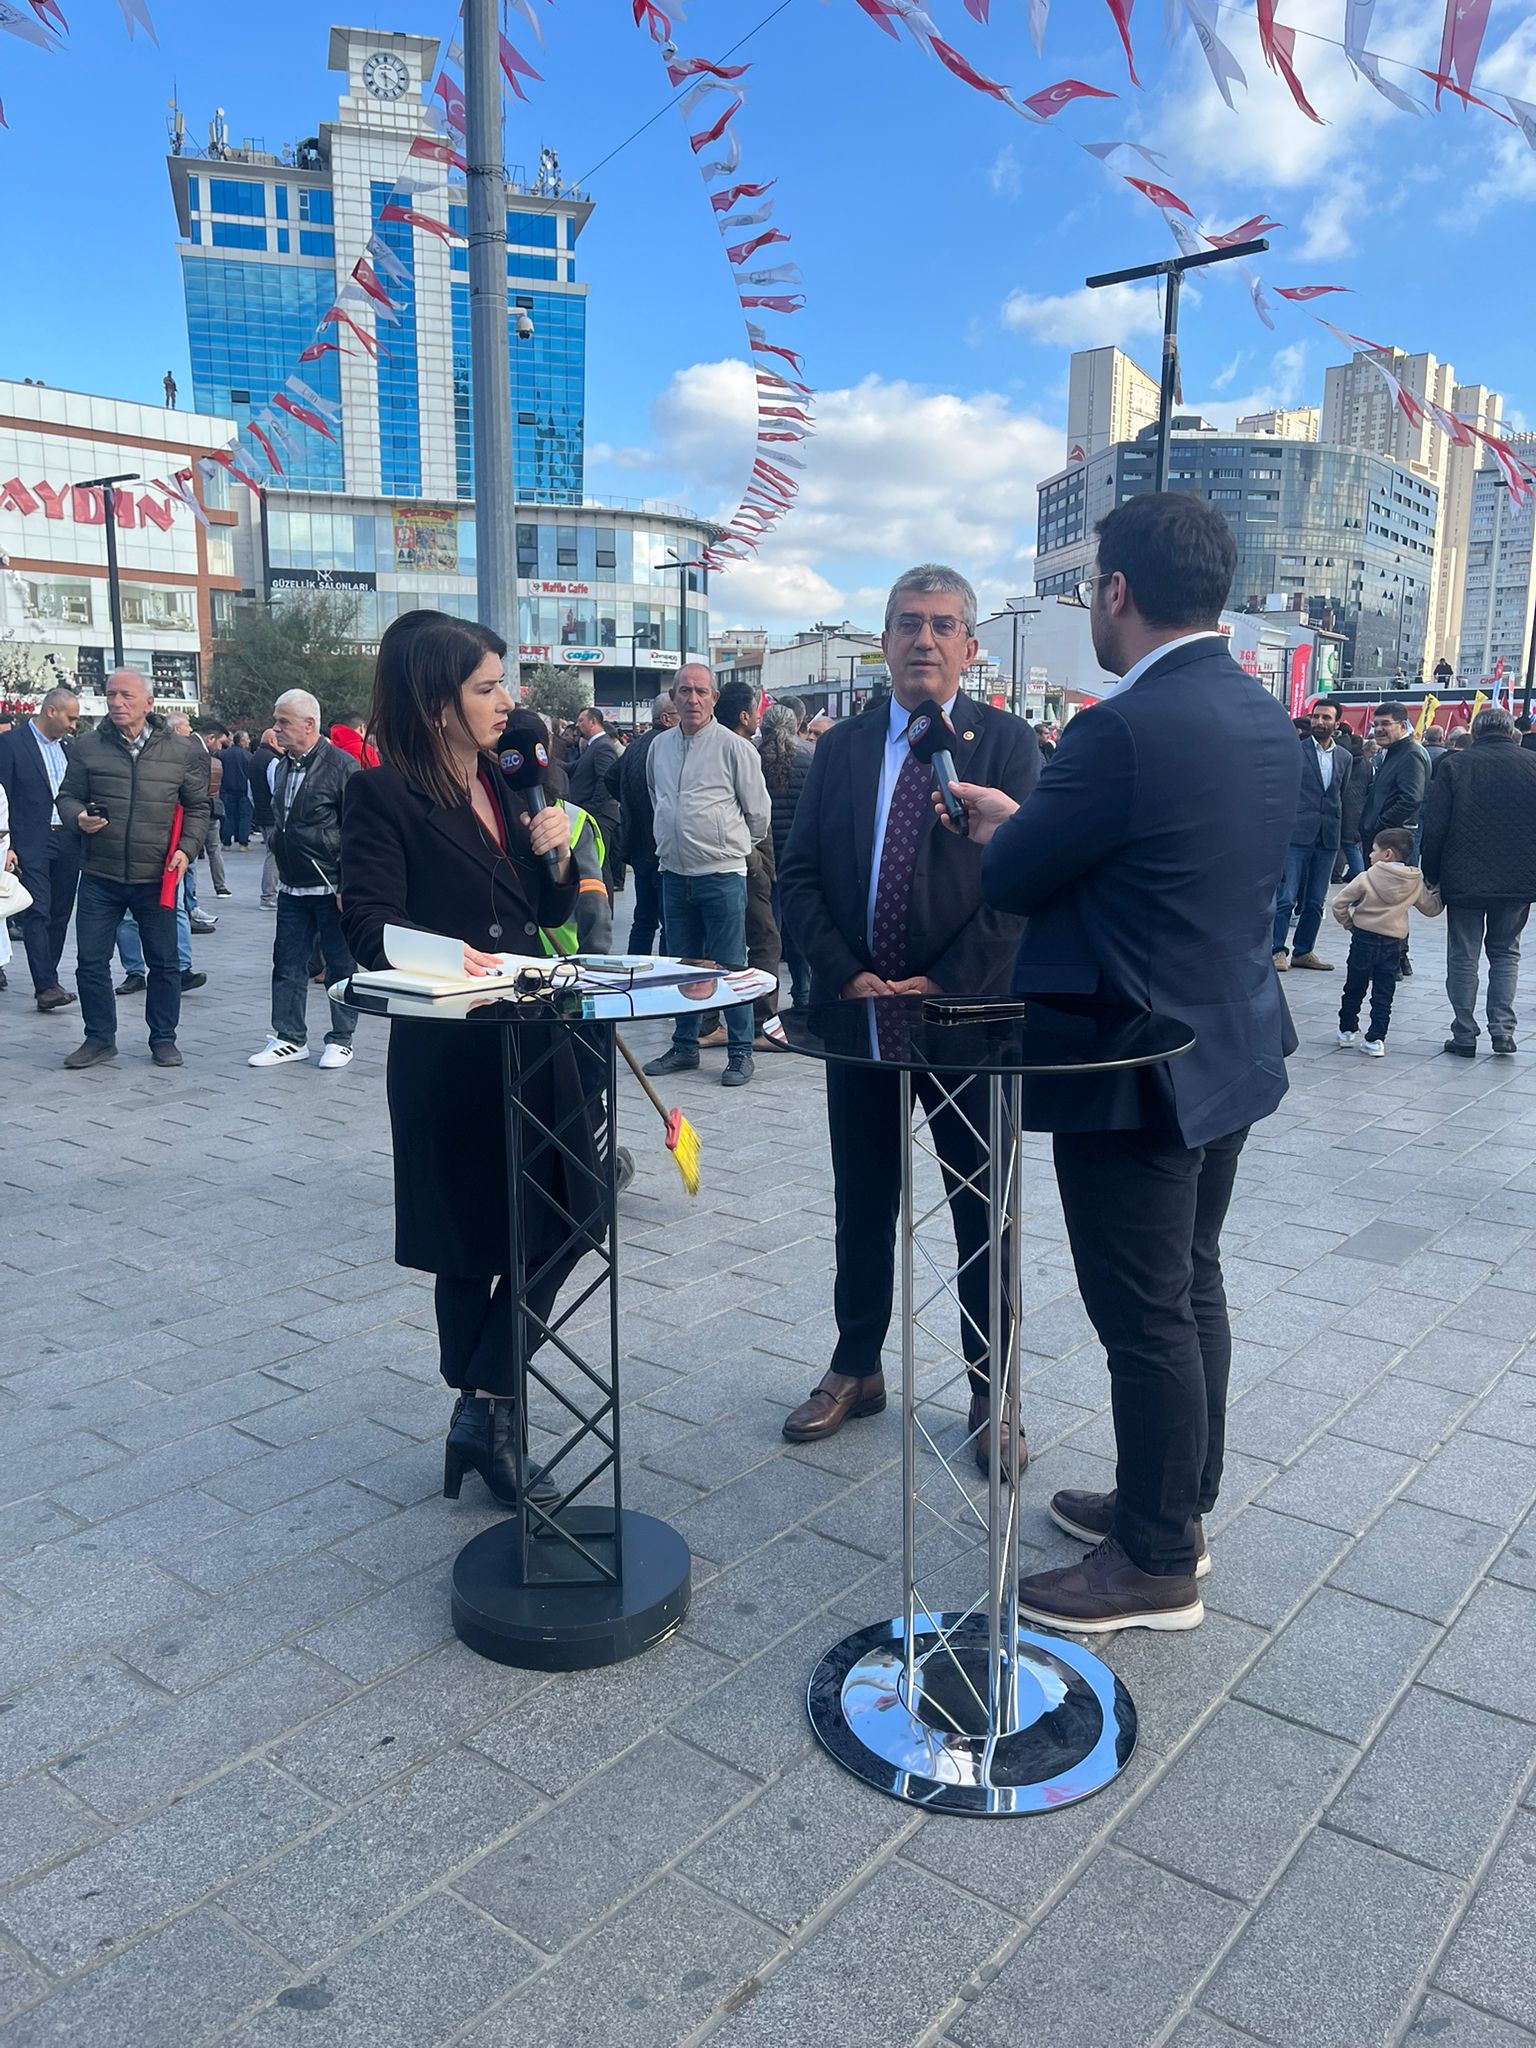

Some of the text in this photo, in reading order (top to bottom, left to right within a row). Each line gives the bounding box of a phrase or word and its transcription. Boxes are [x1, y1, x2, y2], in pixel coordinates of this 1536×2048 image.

[0, 477, 175, 532] AYDIN
[272, 578, 369, 591] GÜZELLİK SALONLARI
[542, 582, 589, 594] Waffle Caffe
[501, 754, 520, 769] SZC
